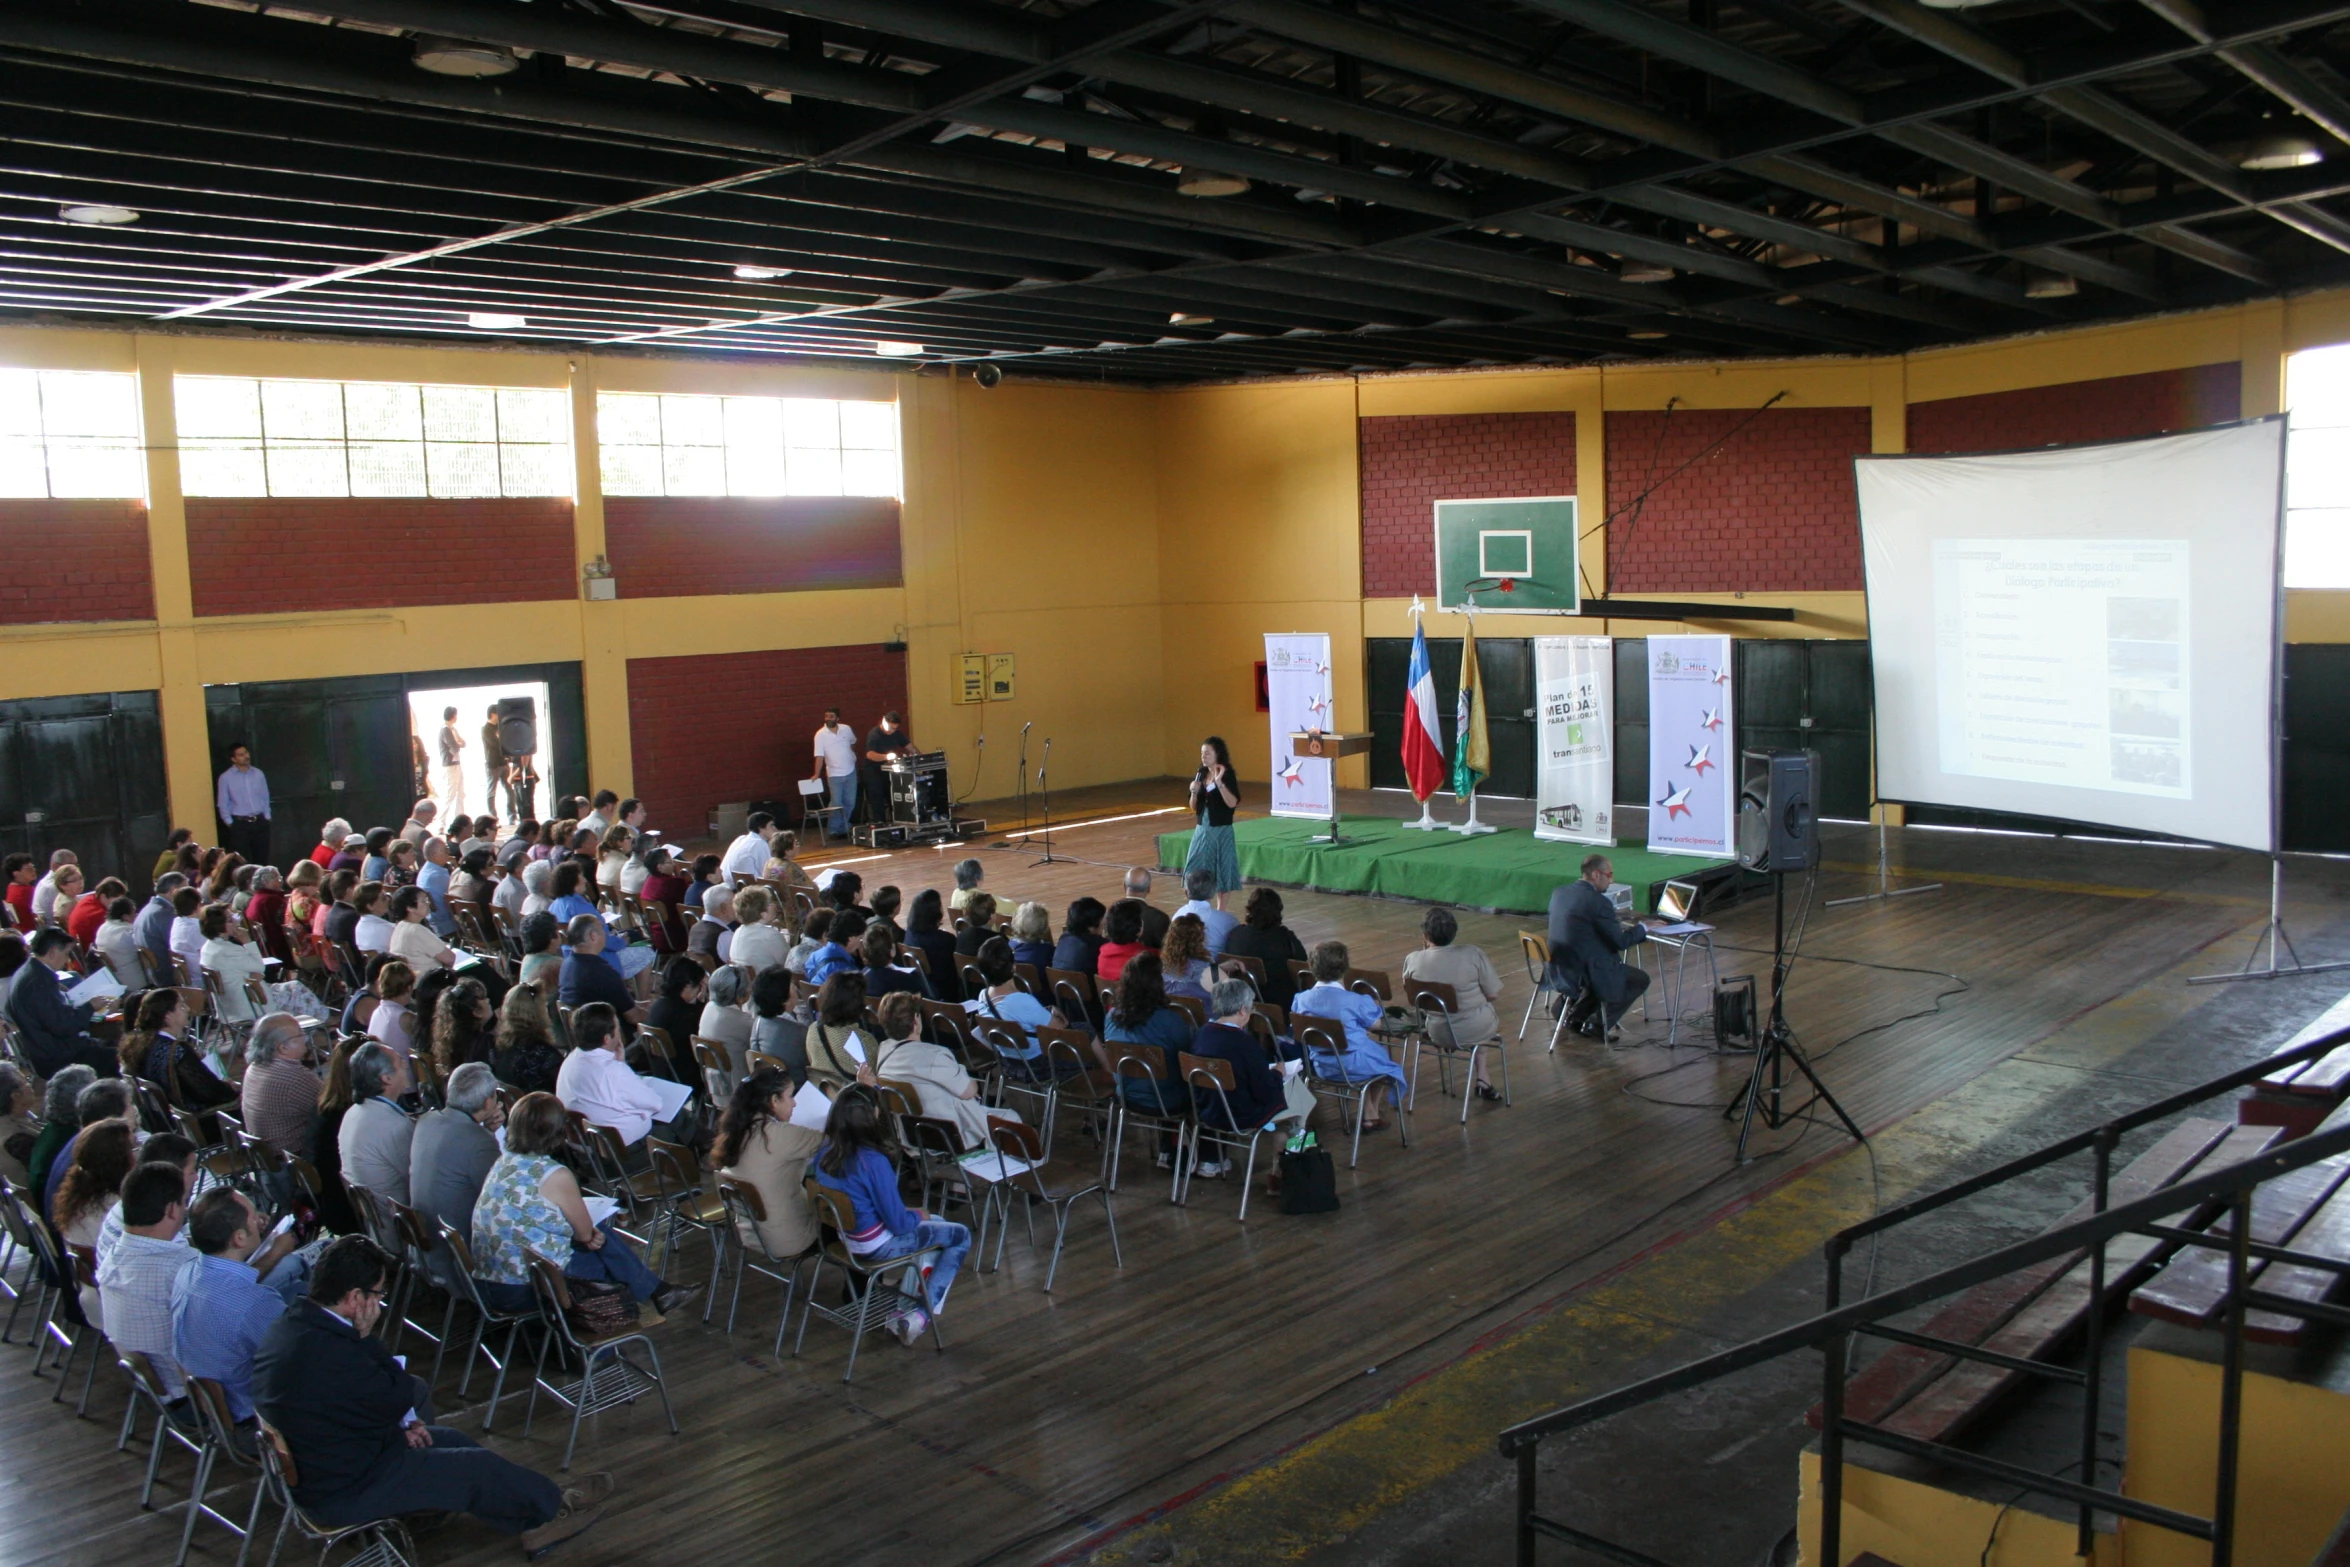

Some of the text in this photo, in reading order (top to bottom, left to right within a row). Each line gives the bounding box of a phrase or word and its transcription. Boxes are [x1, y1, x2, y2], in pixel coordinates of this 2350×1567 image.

[1544, 693, 1565, 703] Plan
[1580, 684, 1595, 697] 15
[1545, 699, 1598, 718] MEDIDAS
[1547, 710, 1599, 725] PARA MEJORAR
[1553, 745, 1602, 759] transantiago
